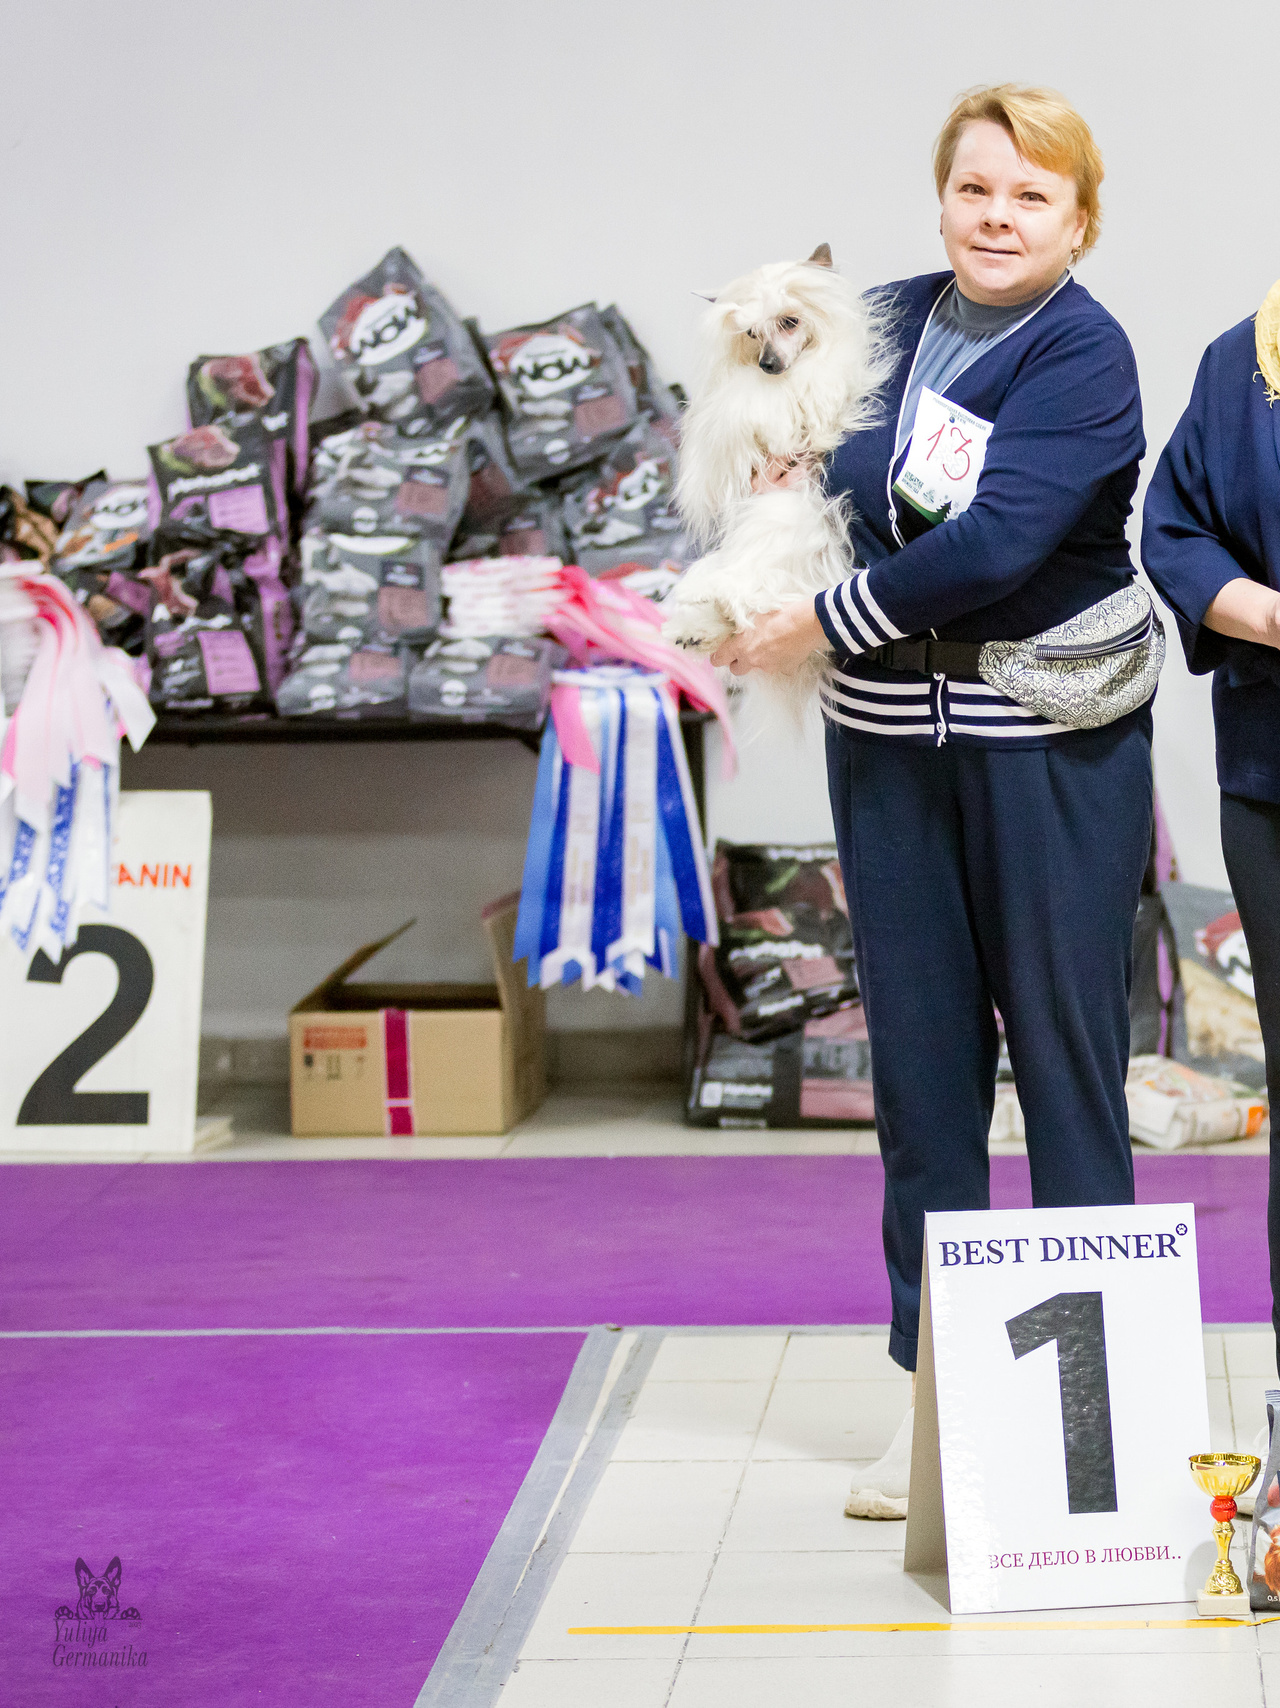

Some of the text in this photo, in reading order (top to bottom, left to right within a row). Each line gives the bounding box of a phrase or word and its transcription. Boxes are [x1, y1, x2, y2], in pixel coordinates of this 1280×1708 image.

[926, 423, 973, 481] 13
[112, 861, 192, 889] ANIN
[16, 924, 154, 1126] 2
[939, 1233, 1181, 1267] BEST DINNER
[1004, 1291, 1119, 1515] 1
[988, 1546, 1182, 1571] ВСЕ ДЕЛО В ЛЮБВИ..
